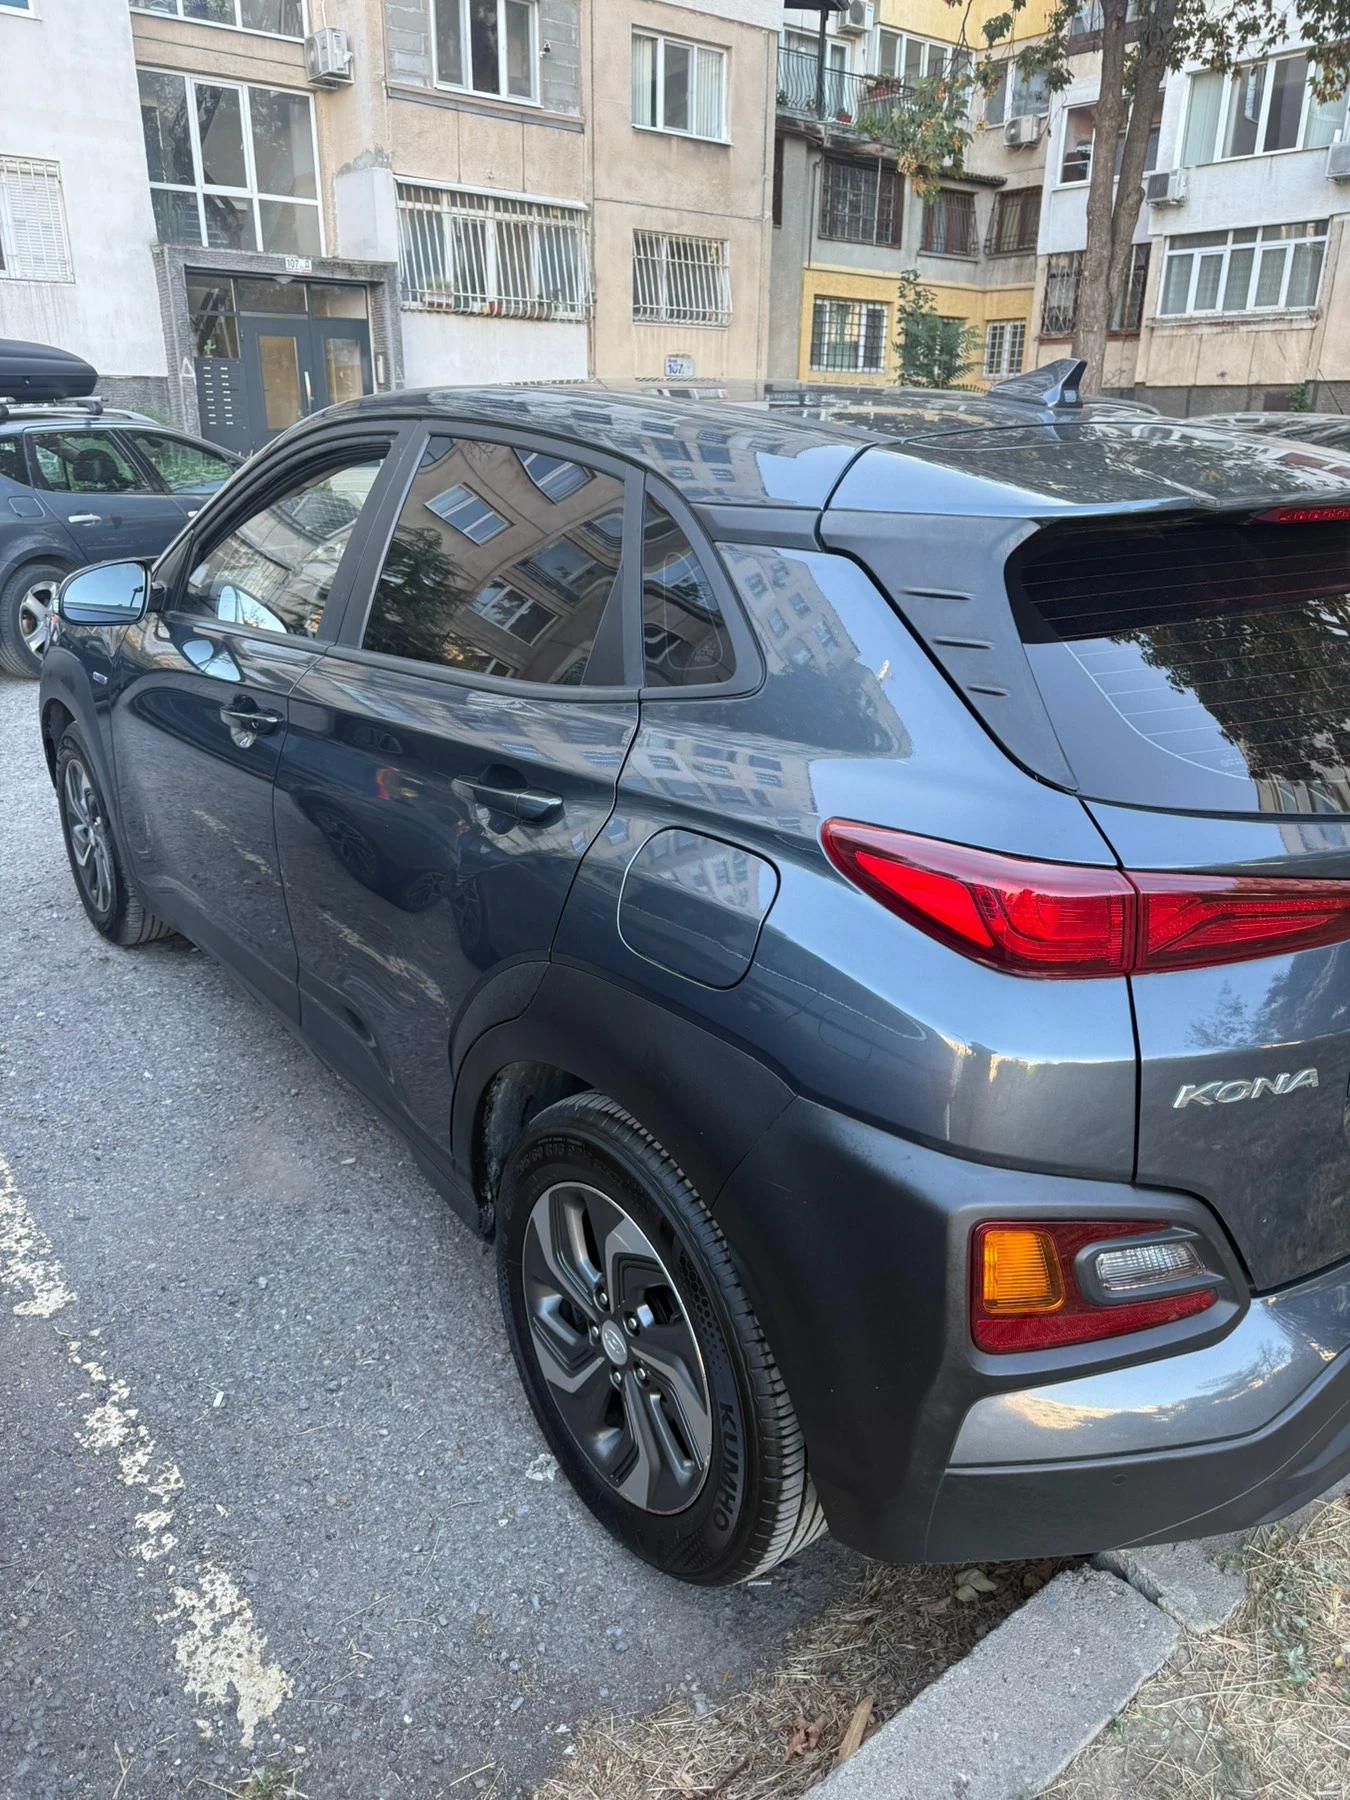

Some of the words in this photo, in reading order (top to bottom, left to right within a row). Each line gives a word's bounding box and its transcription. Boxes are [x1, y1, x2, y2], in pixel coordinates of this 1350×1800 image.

[287, 259, 299, 268] 107
[668, 363, 683, 374] 107
[1173, 1068, 1319, 1109] KONA
[713, 1402, 739, 1532] KUMHO
